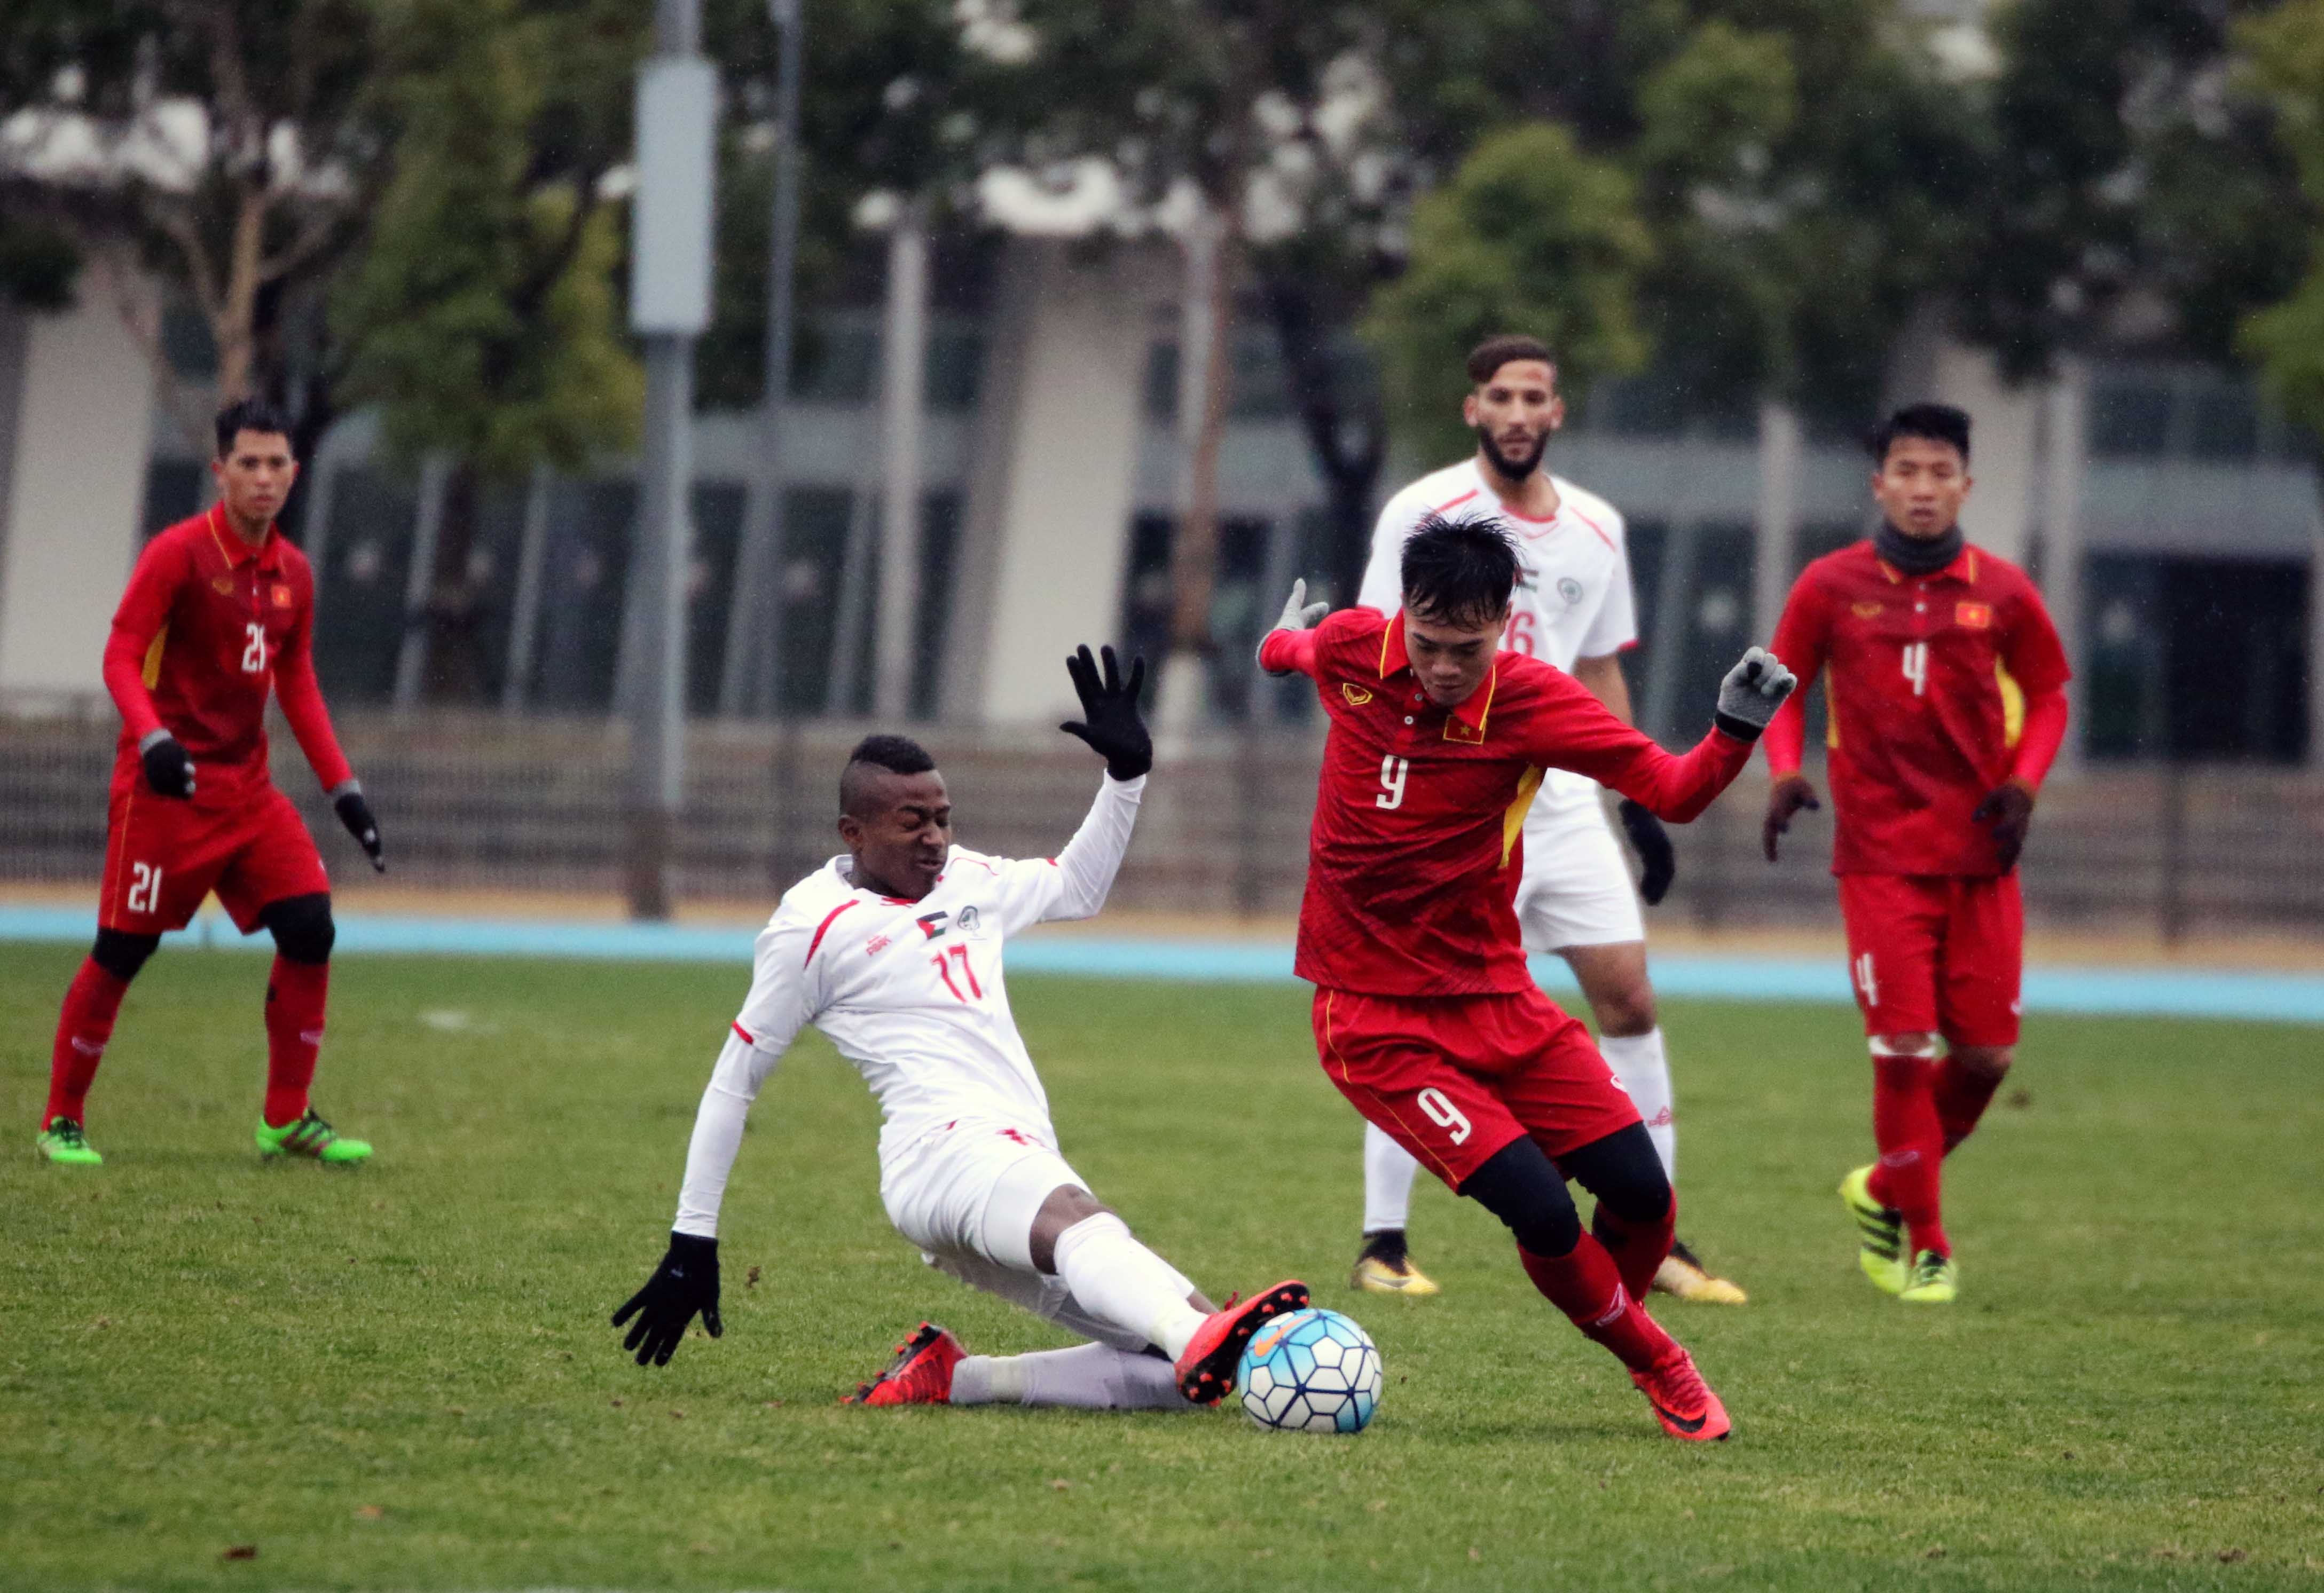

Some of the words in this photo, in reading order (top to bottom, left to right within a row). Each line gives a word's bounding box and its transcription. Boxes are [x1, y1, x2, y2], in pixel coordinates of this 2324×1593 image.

[241, 622, 266, 672] 21
[1903, 643, 1926, 696] 4
[1376, 754, 1409, 810] 9
[128, 861, 162, 914] 21
[930, 941, 982, 1004] 17
[1856, 952, 1878, 1007] 4
[1417, 1087, 1471, 1146] 9
